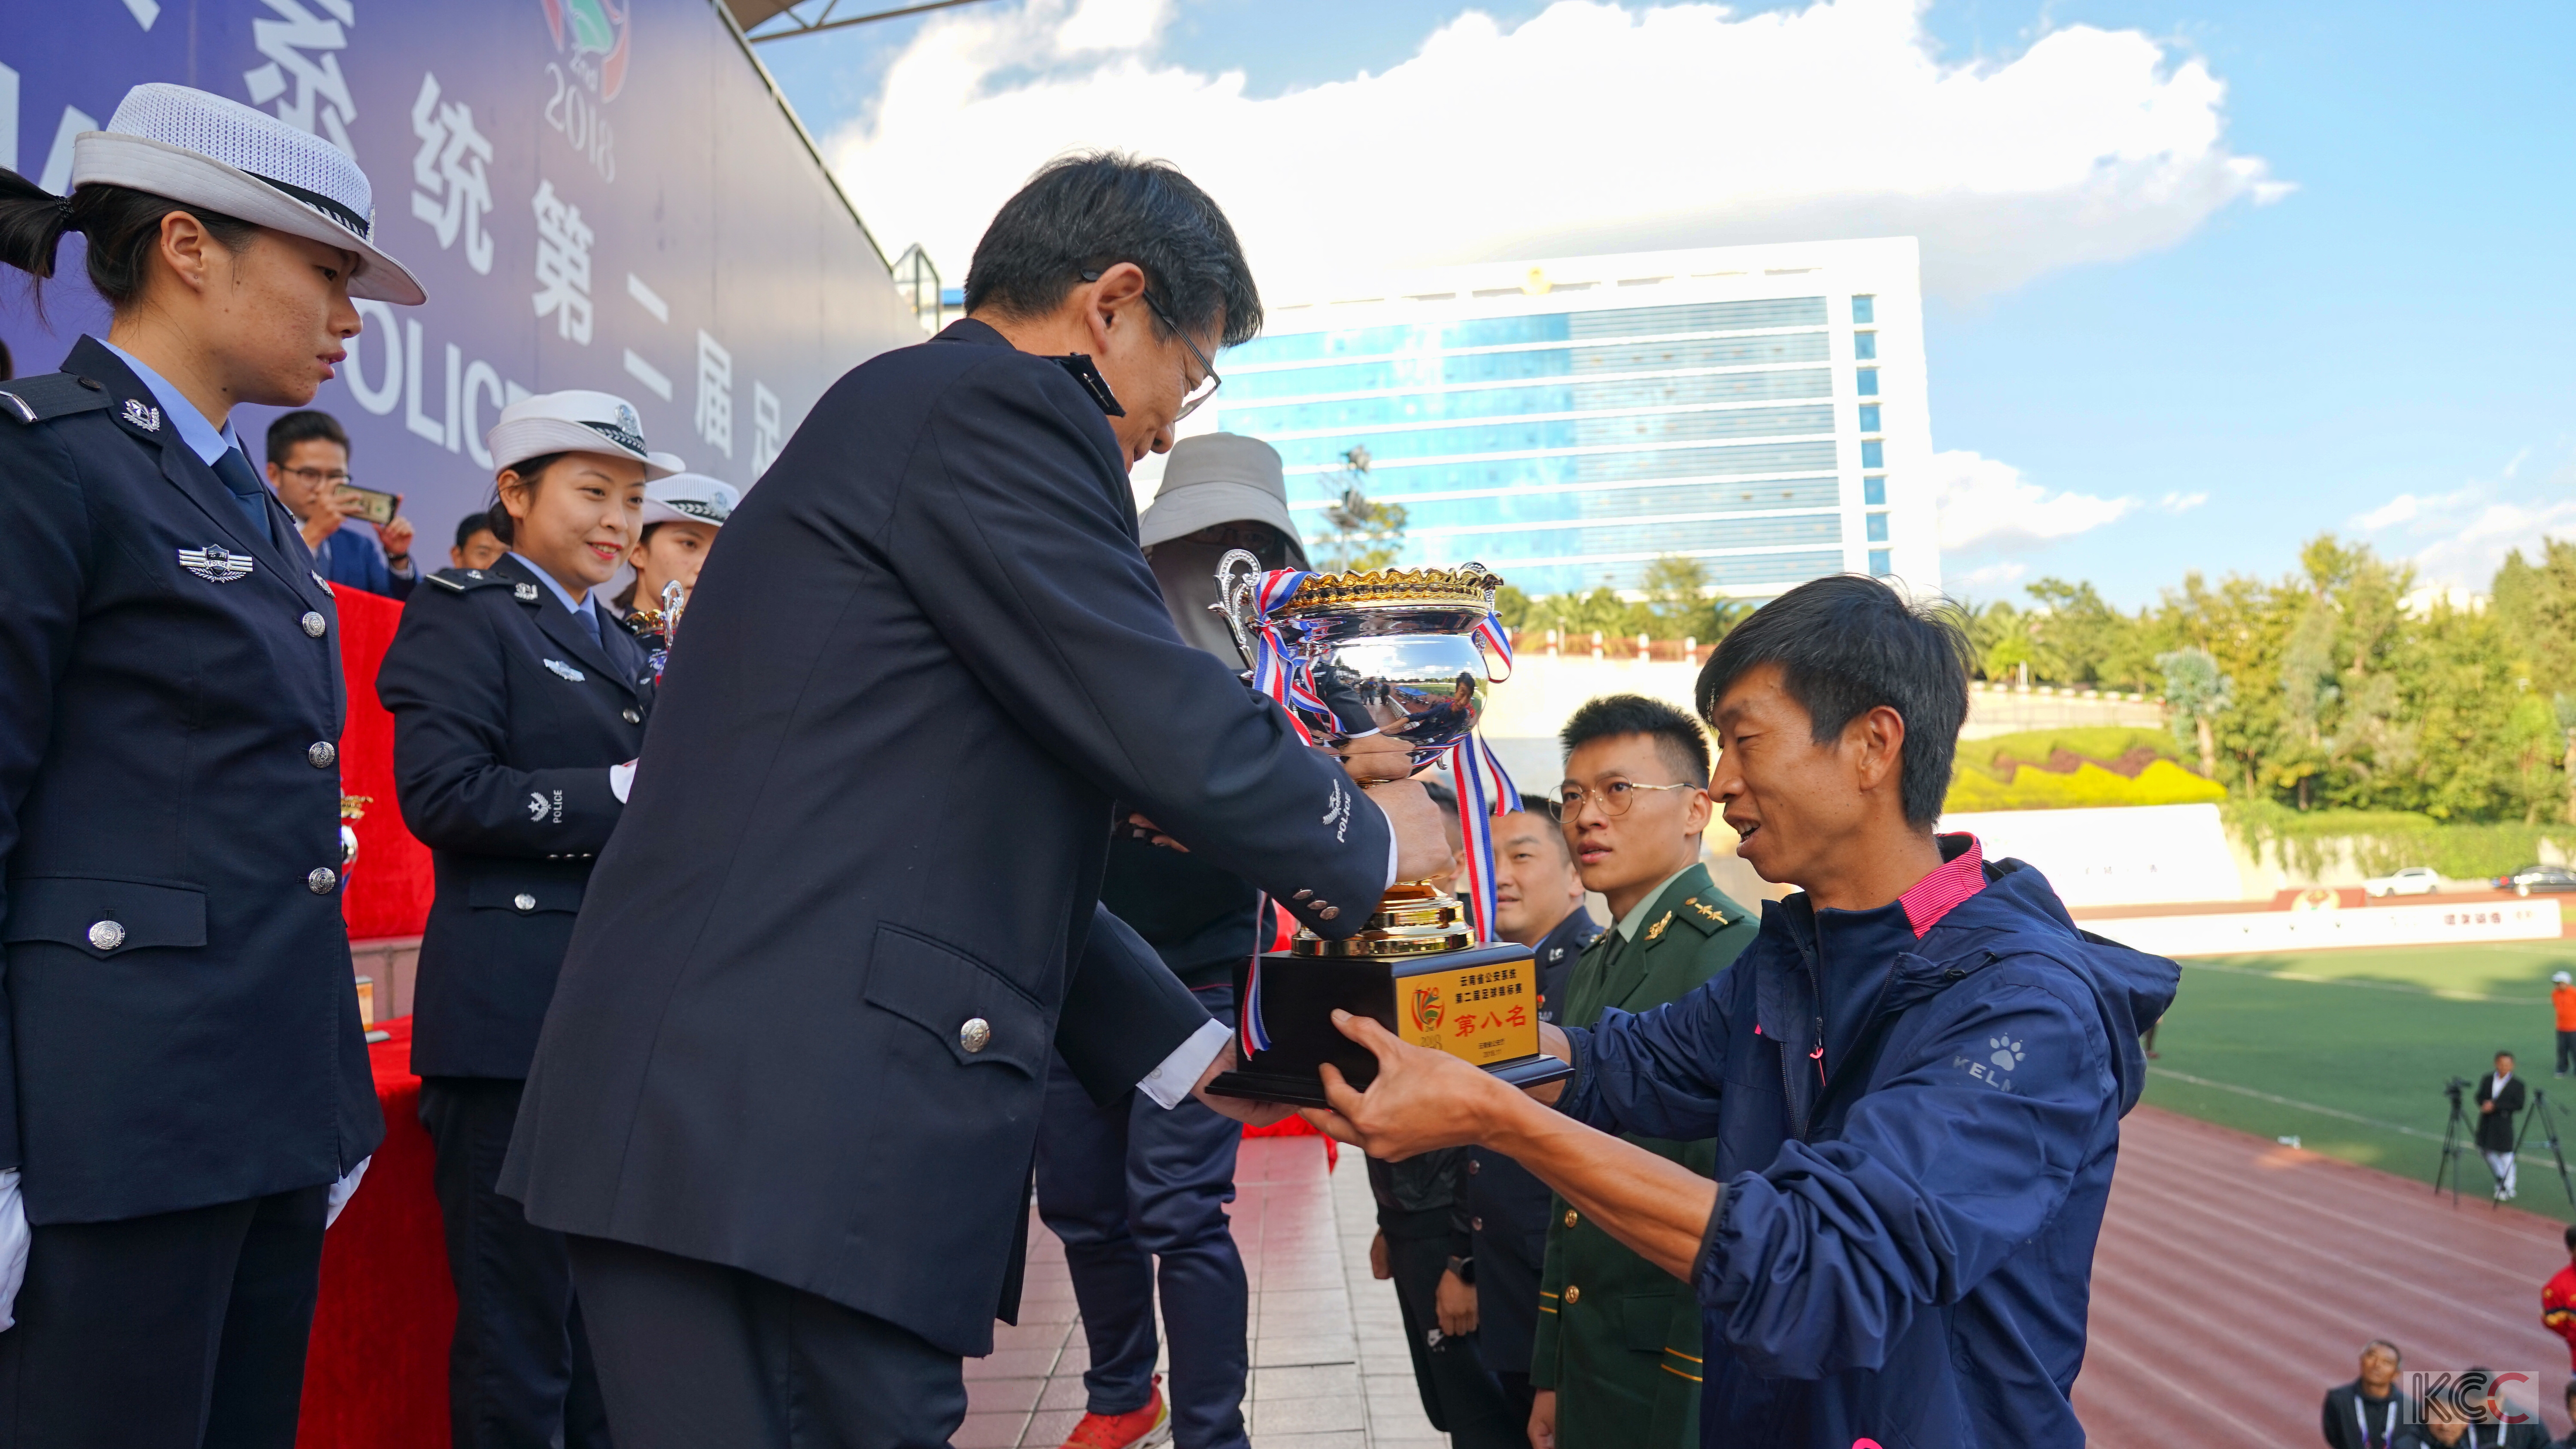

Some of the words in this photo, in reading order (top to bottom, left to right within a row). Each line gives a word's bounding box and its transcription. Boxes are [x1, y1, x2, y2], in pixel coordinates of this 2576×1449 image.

[544, 61, 616, 185] 2018
[243, 0, 781, 479] 系统第二届足
[342, 294, 537, 471] OLIC
[553, 789, 563, 824] POLICE
[1337, 791, 1351, 843] POLICE
[1455, 983, 1523, 1004] 第二届足球锦标赛
[1460, 968, 1517, 987] 云南省公安系统
[1454, 1004, 1527, 1038] 第八名
